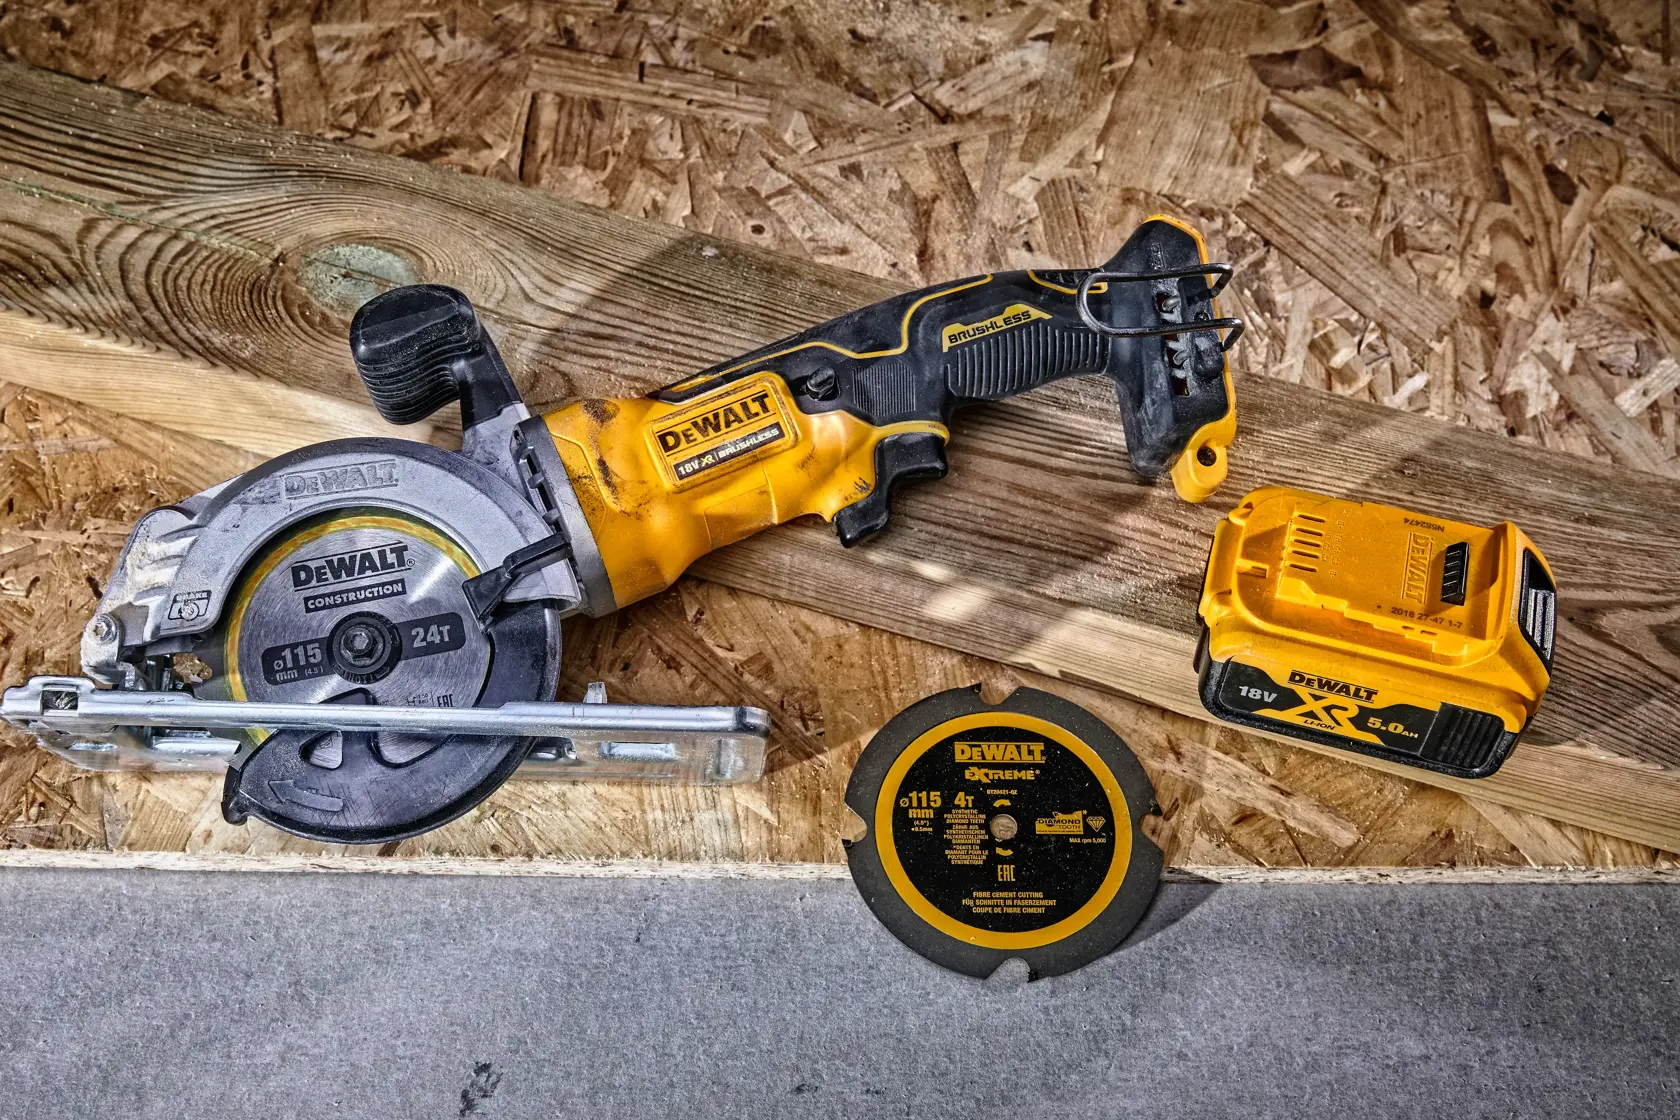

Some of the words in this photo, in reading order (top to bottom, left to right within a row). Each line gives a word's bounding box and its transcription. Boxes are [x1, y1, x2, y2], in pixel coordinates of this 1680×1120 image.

[947, 310, 1032, 344] BRUSHLESS
[657, 392, 771, 454] DEWALT
[678, 461, 699, 475] 18V
[718, 428, 780, 459] BRUSHLESS
[284, 462, 398, 496] DEWALT
[291, 544, 409, 588] DEWALT
[1404, 532, 1431, 604] DEWALT
[307, 583, 403, 609] CONSTRUCTION
[1391, 607, 1415, 619] 2018
[1417, 612, 1444, 625] 27-47
[1448, 620, 1463, 629] 1-7
[411, 624, 451, 648] 24T
[276, 669, 299, 681] mm
[1288, 671, 1378, 702] DEWALT
[1238, 685, 1278, 703] 18V
[955, 743, 1045, 762] DEWALT
[954, 791, 975, 808] 4T
[908, 808, 934, 819] mm
[962, 898, 974, 906] FÜR
